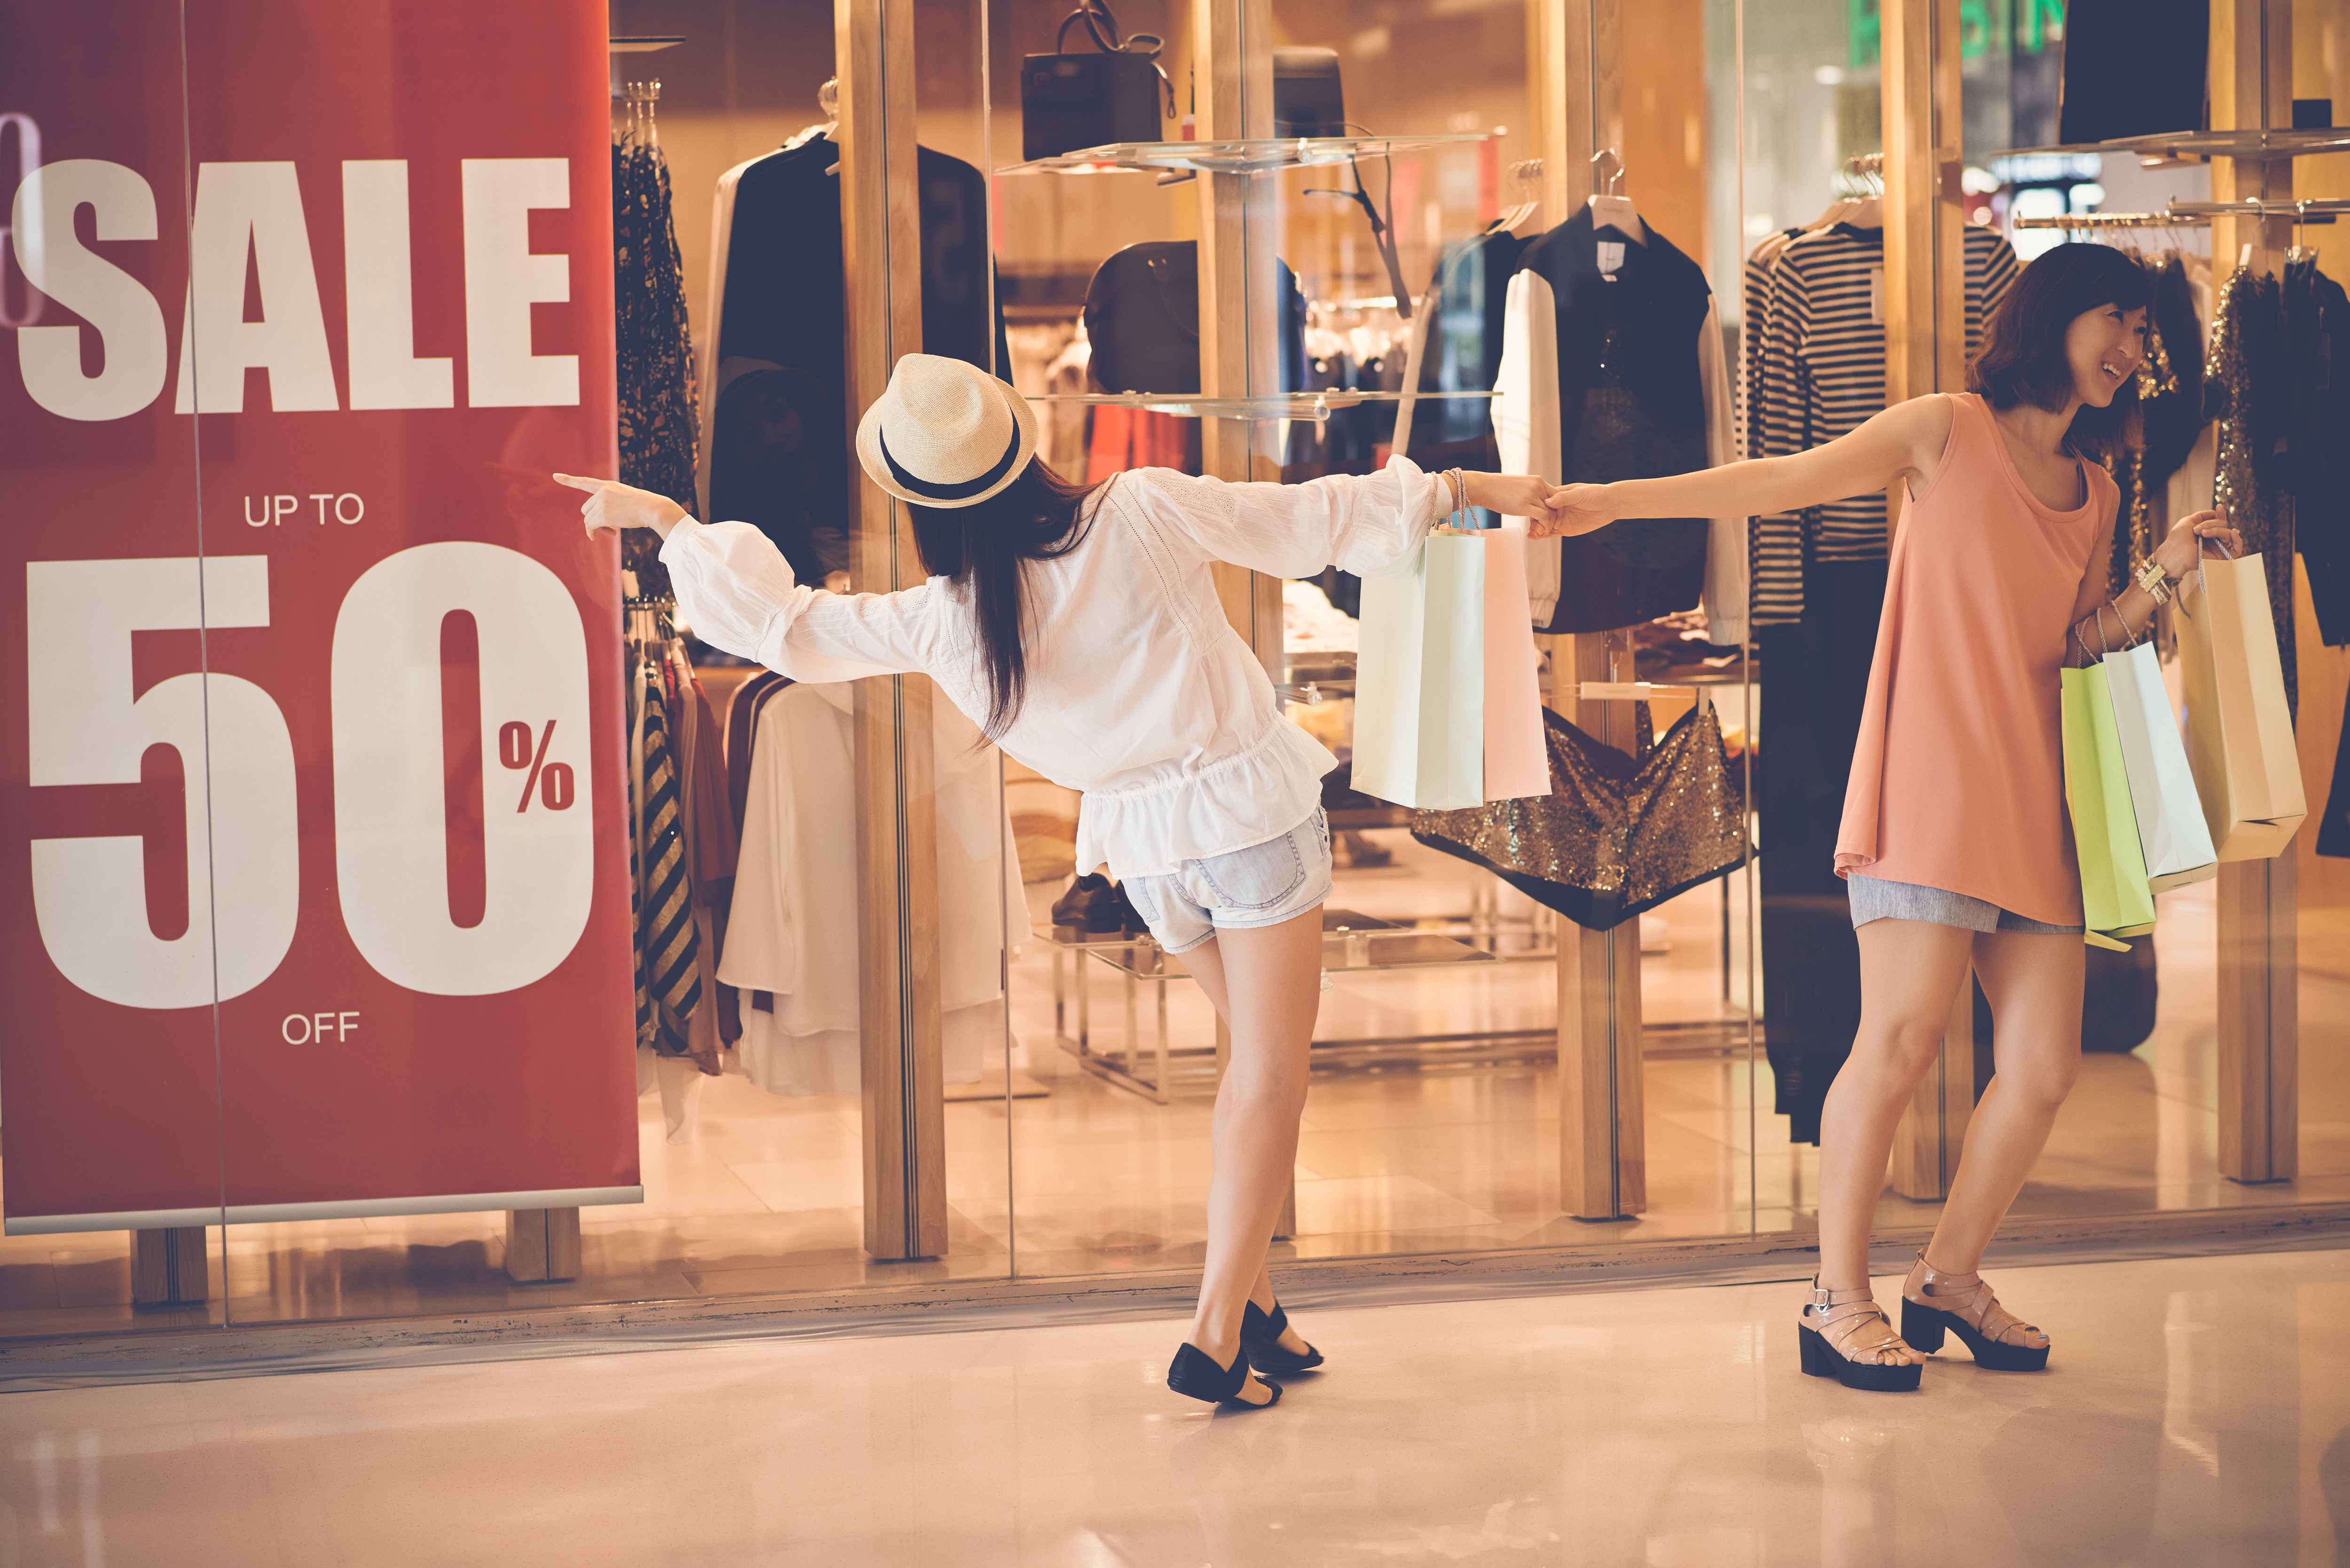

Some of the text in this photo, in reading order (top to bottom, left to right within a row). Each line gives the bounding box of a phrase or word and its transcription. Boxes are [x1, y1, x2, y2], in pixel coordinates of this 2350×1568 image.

[12, 158, 580, 421] SALE
[244, 493, 364, 527] UP TO
[282, 1011, 360, 1045] OFF
